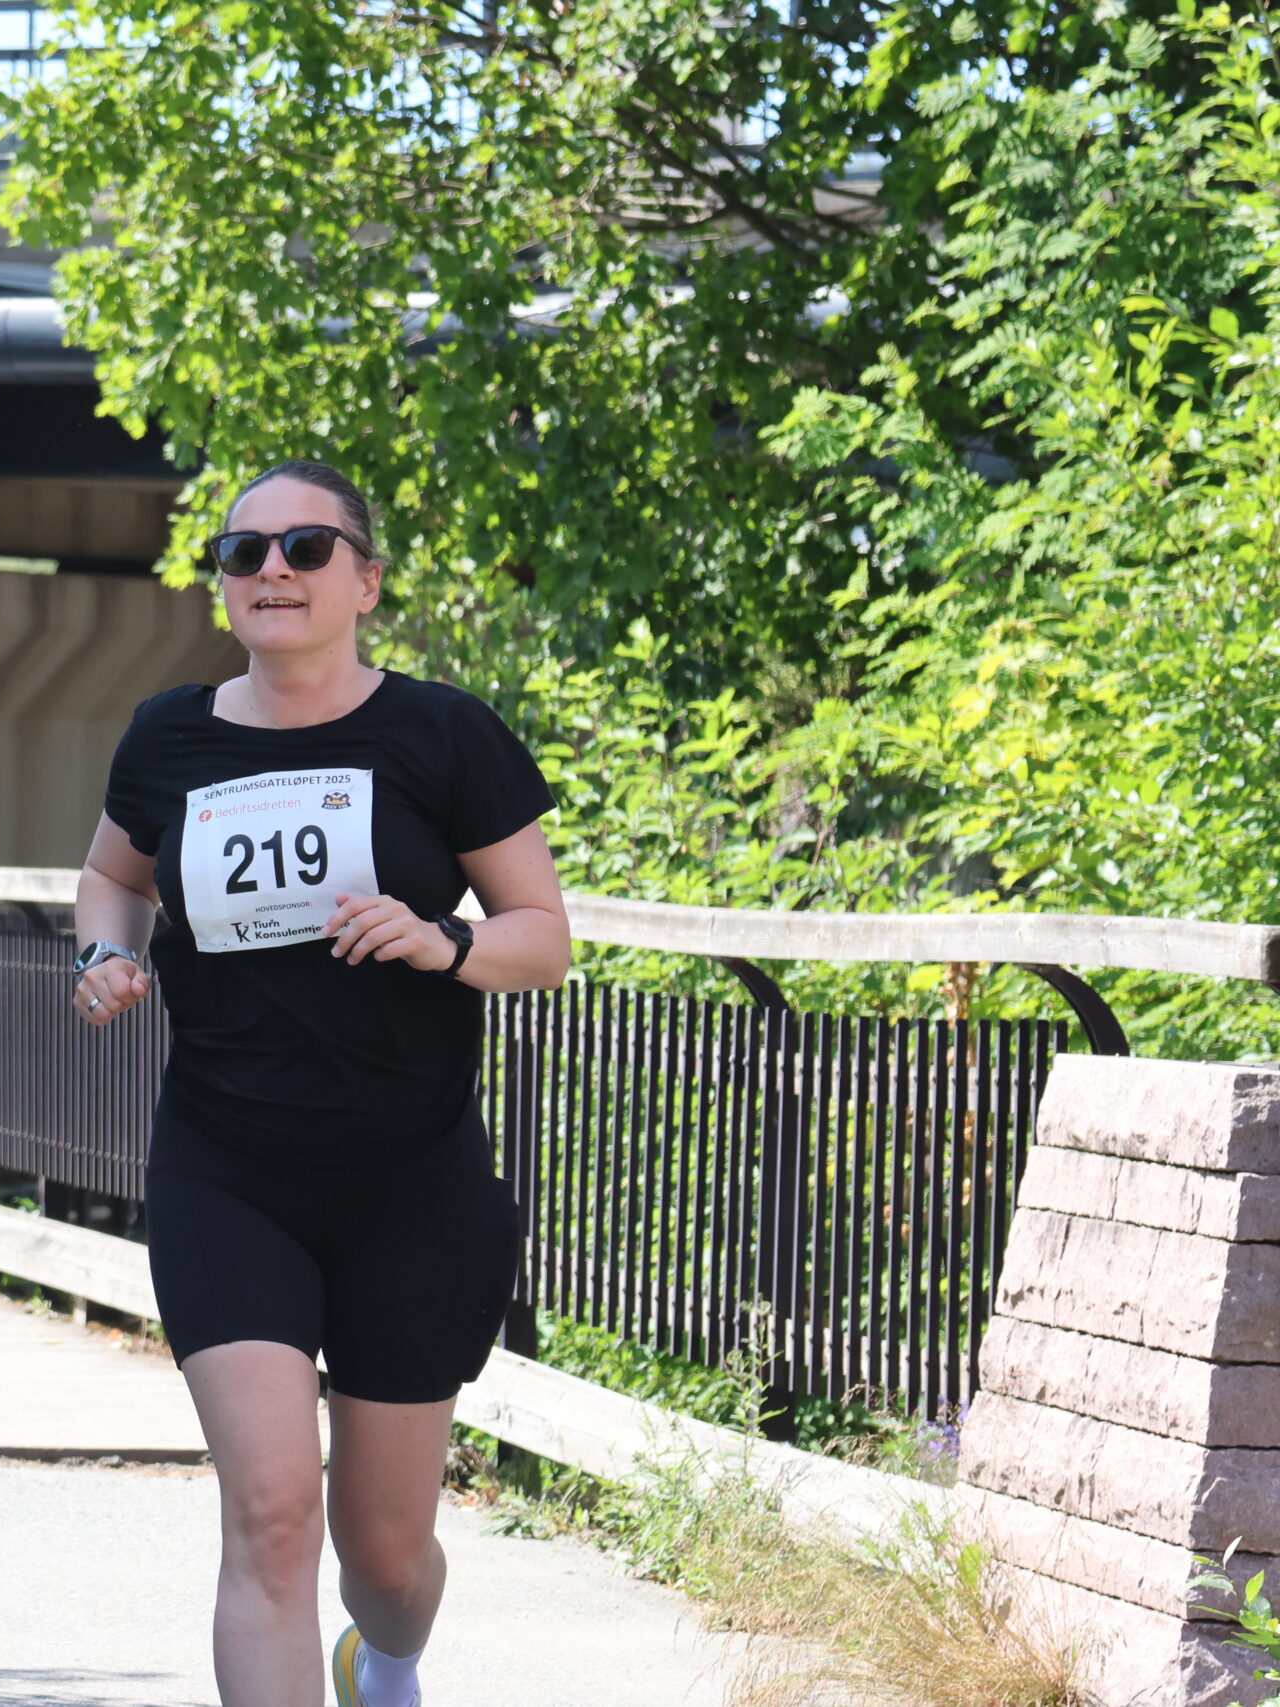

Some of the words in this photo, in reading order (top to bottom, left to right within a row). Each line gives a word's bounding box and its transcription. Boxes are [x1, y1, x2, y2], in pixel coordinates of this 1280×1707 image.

[204, 776, 322, 800] SENTRUMSGATELØPET
[325, 774, 351, 784] 2025
[215, 799, 301, 818] Bedriftsidretten
[223, 824, 328, 895] 219
[255, 901, 313, 913] HOVEDSPONSOR:
